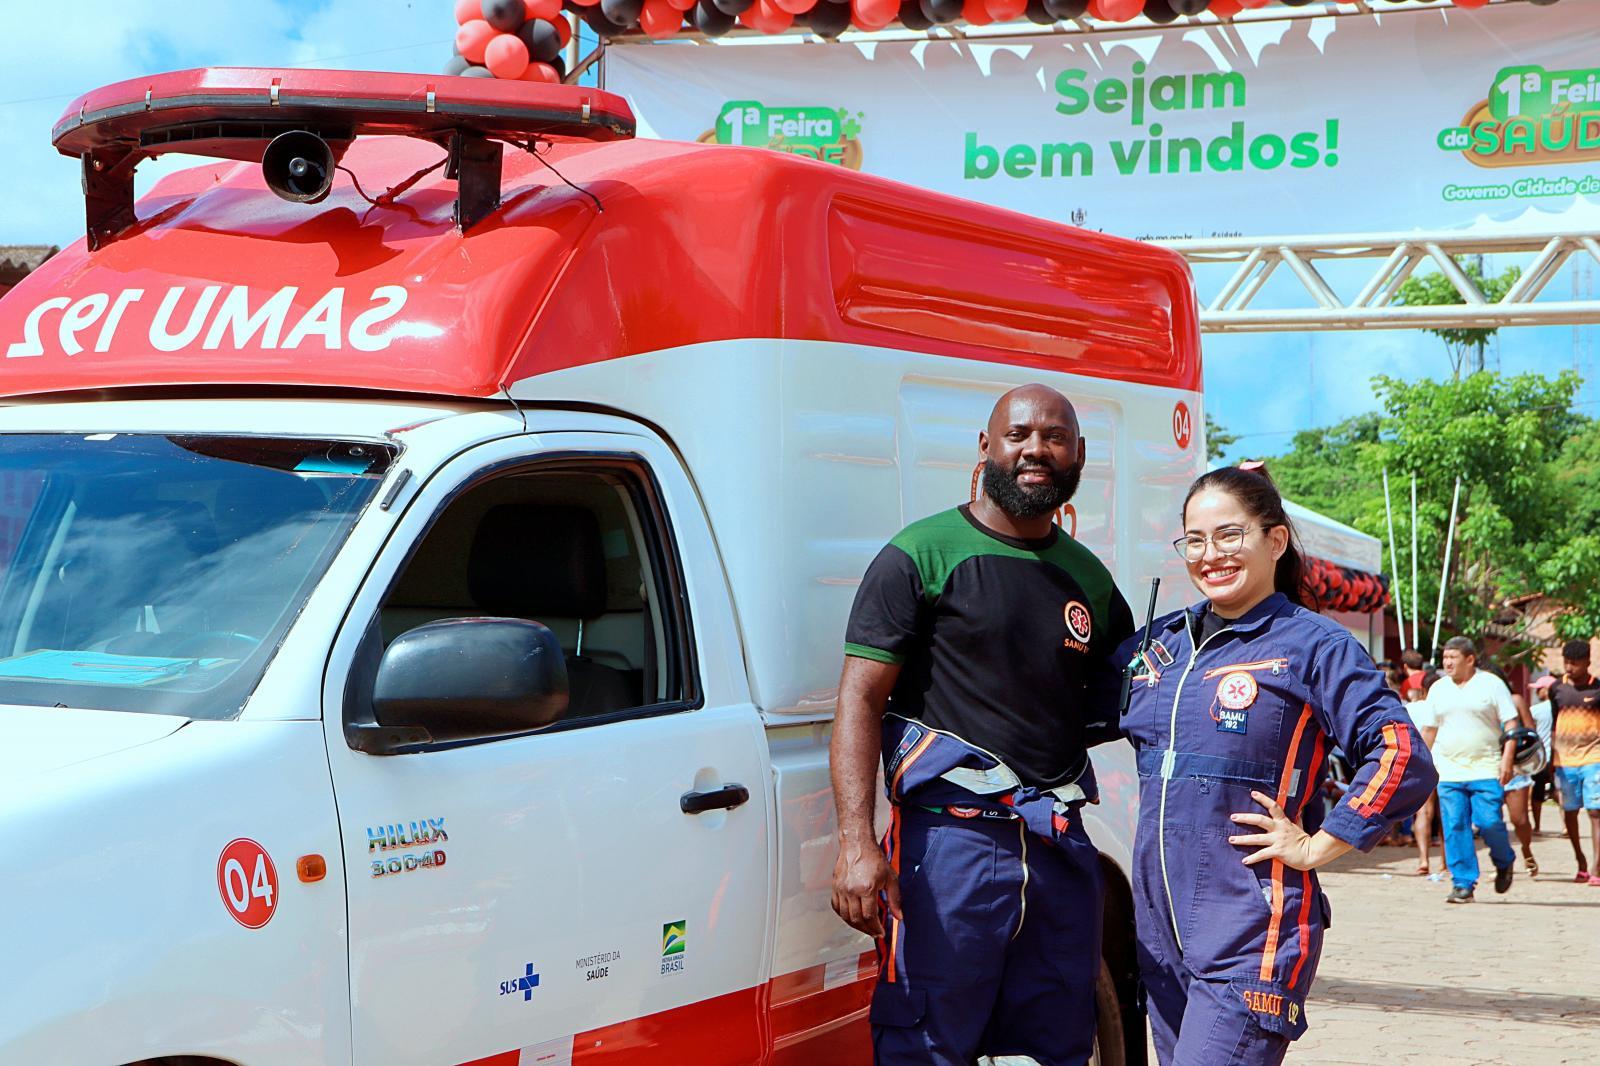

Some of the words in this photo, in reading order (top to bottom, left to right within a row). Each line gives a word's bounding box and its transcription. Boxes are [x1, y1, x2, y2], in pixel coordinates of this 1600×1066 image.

[1055, 61, 1246, 125] Sejam
[767, 112, 833, 138] Feira
[964, 132, 1093, 180] bem
[1110, 119, 1339, 176] vindos!
[1443, 130, 1469, 147] da
[1443, 184, 1509, 199] Governo
[1514, 177, 1577, 197] Cidade
[1579, 176, 1600, 194] de
[1174, 409, 1190, 441] 04
[1220, 710, 1245, 722] SAMU
[1224, 719, 1239, 730] 192
[367, 817, 449, 852] HILUX
[224, 853, 274, 913] 04
[575, 951, 612, 969] MINISTÉRIO
[612, 950, 622, 961] DA
[660, 959, 685, 975] BRASIL
[586, 966, 609, 981] SAÚDE
[499, 979, 518, 996] SUS
[1243, 990, 1283, 1017] SAMU
